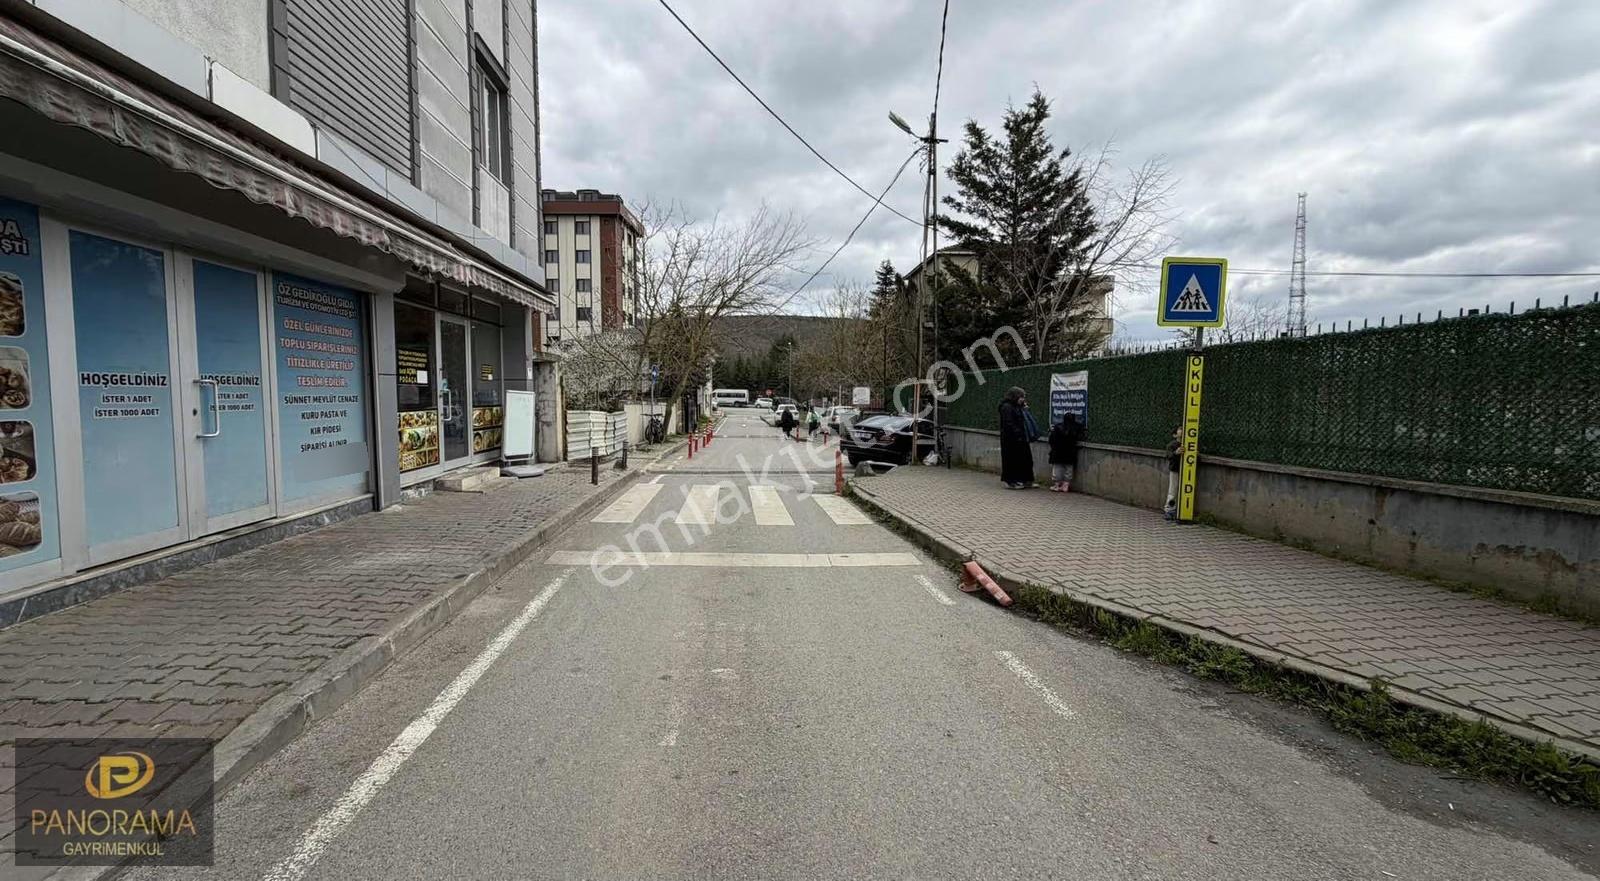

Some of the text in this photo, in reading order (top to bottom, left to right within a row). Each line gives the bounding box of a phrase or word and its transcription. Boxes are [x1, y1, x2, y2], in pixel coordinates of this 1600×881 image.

[278, 282, 291, 295] ÖZ
[284, 317, 353, 338] ÖZEL GÜNLERİNİZDE
[281, 338, 305, 349] TOPLU
[287, 355, 325, 369] TİTİZLİKLE
[81, 372, 168, 388] HOŞGELDİNİZ
[297, 375, 346, 388] TESLİM EDİLİR
[1191, 356, 1201, 406] OKUL
[102, 393, 153, 403] İSTER 1 ADET
[284, 393, 359, 405] SÜNNET MEVLÜT CENAZE
[95, 408, 160, 417] İSTER 1000 ADET
[301, 411, 319, 420] KURU
[320, 410, 339, 419] PASTA
[310, 424, 341, 435] KIR PİDESİ
